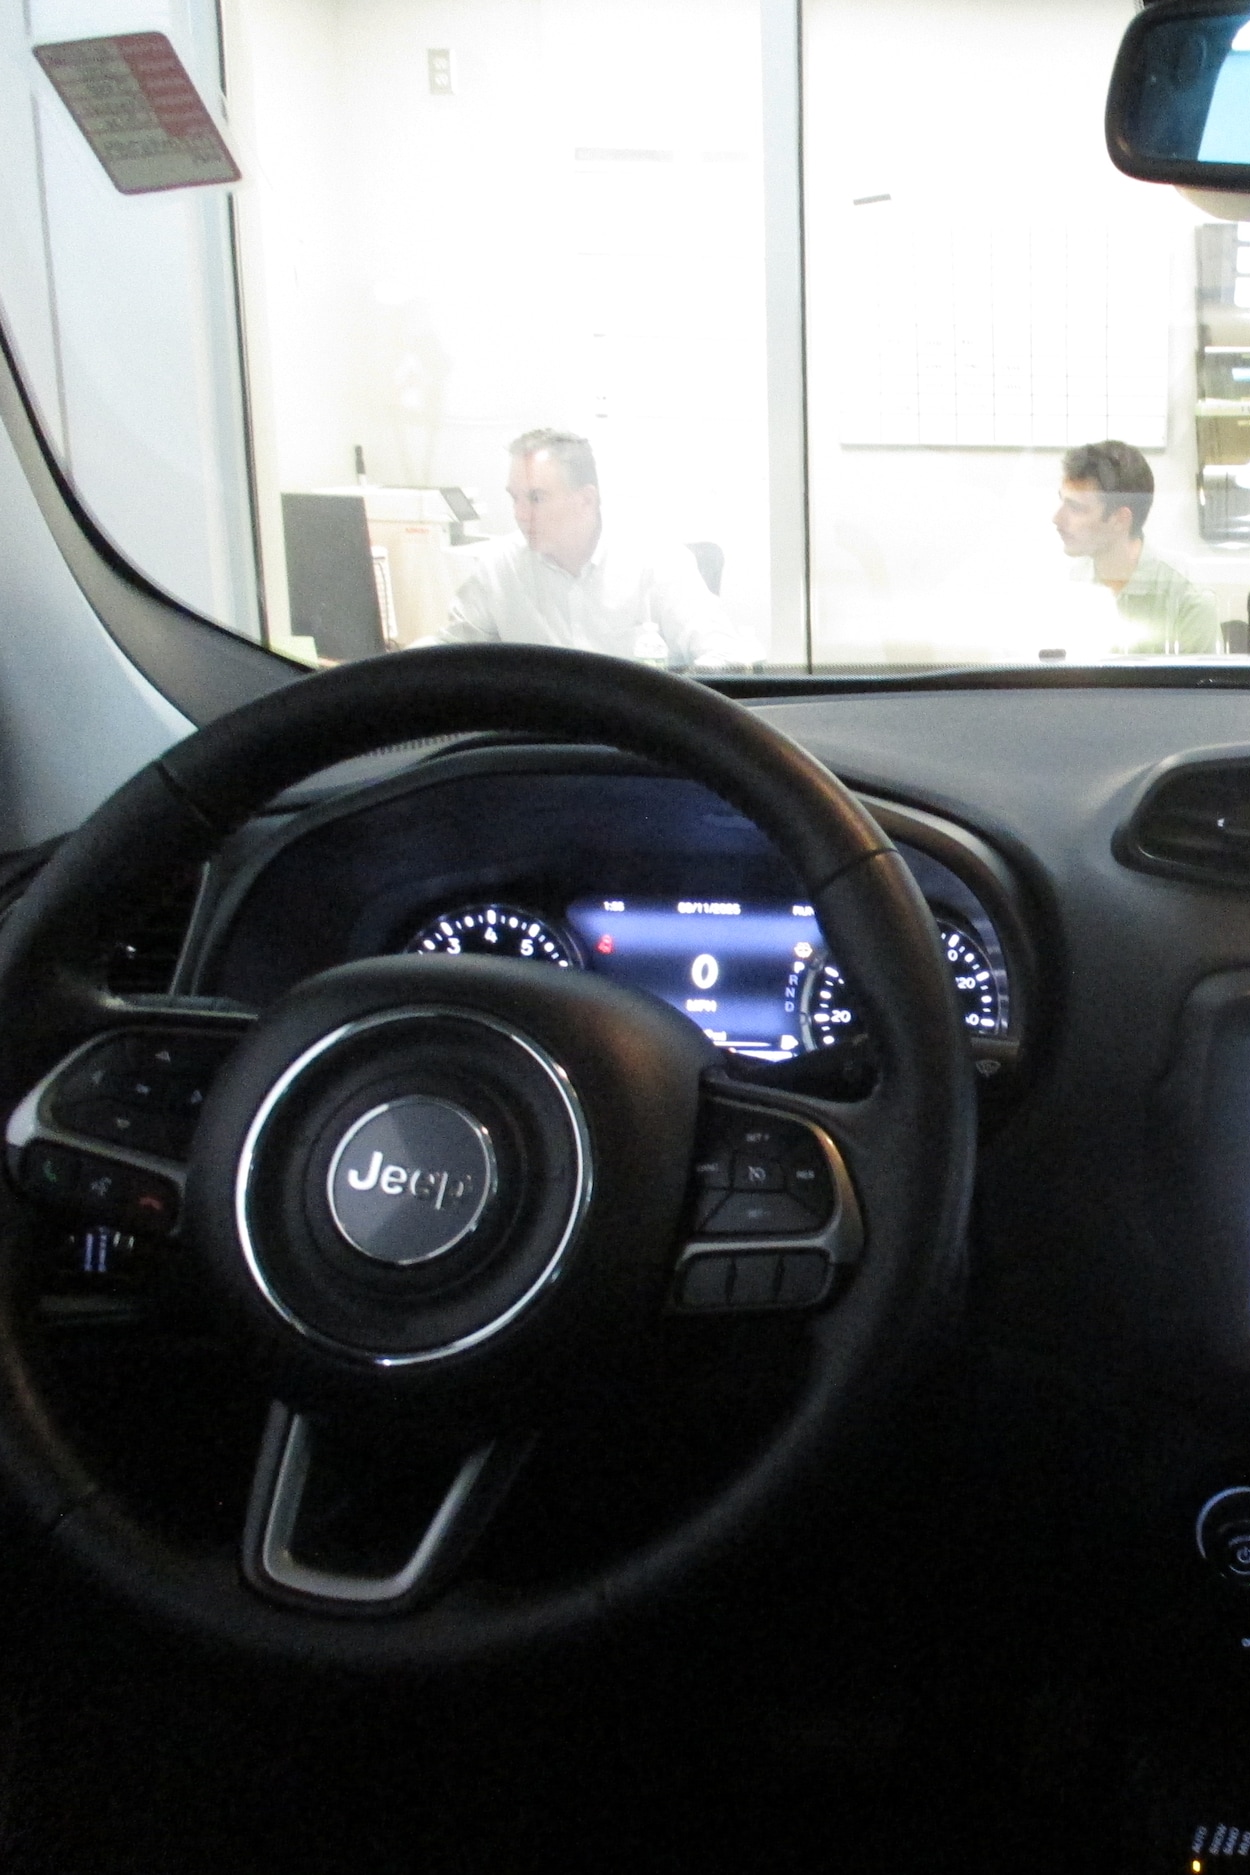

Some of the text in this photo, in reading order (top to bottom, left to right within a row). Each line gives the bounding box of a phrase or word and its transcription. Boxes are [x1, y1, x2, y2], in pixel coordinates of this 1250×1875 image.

[484, 927, 498, 944] 4
[447, 938, 461, 955] 3
[520, 938, 534, 956] 5
[692, 953, 719, 989] 0
[794, 961, 805, 974] P
[789, 974, 799, 985] R
[785, 986, 795, 998] N
[686, 998, 718, 1012] MPH
[784, 1000, 795, 1012] D
[830, 1009, 851, 1023] 20
